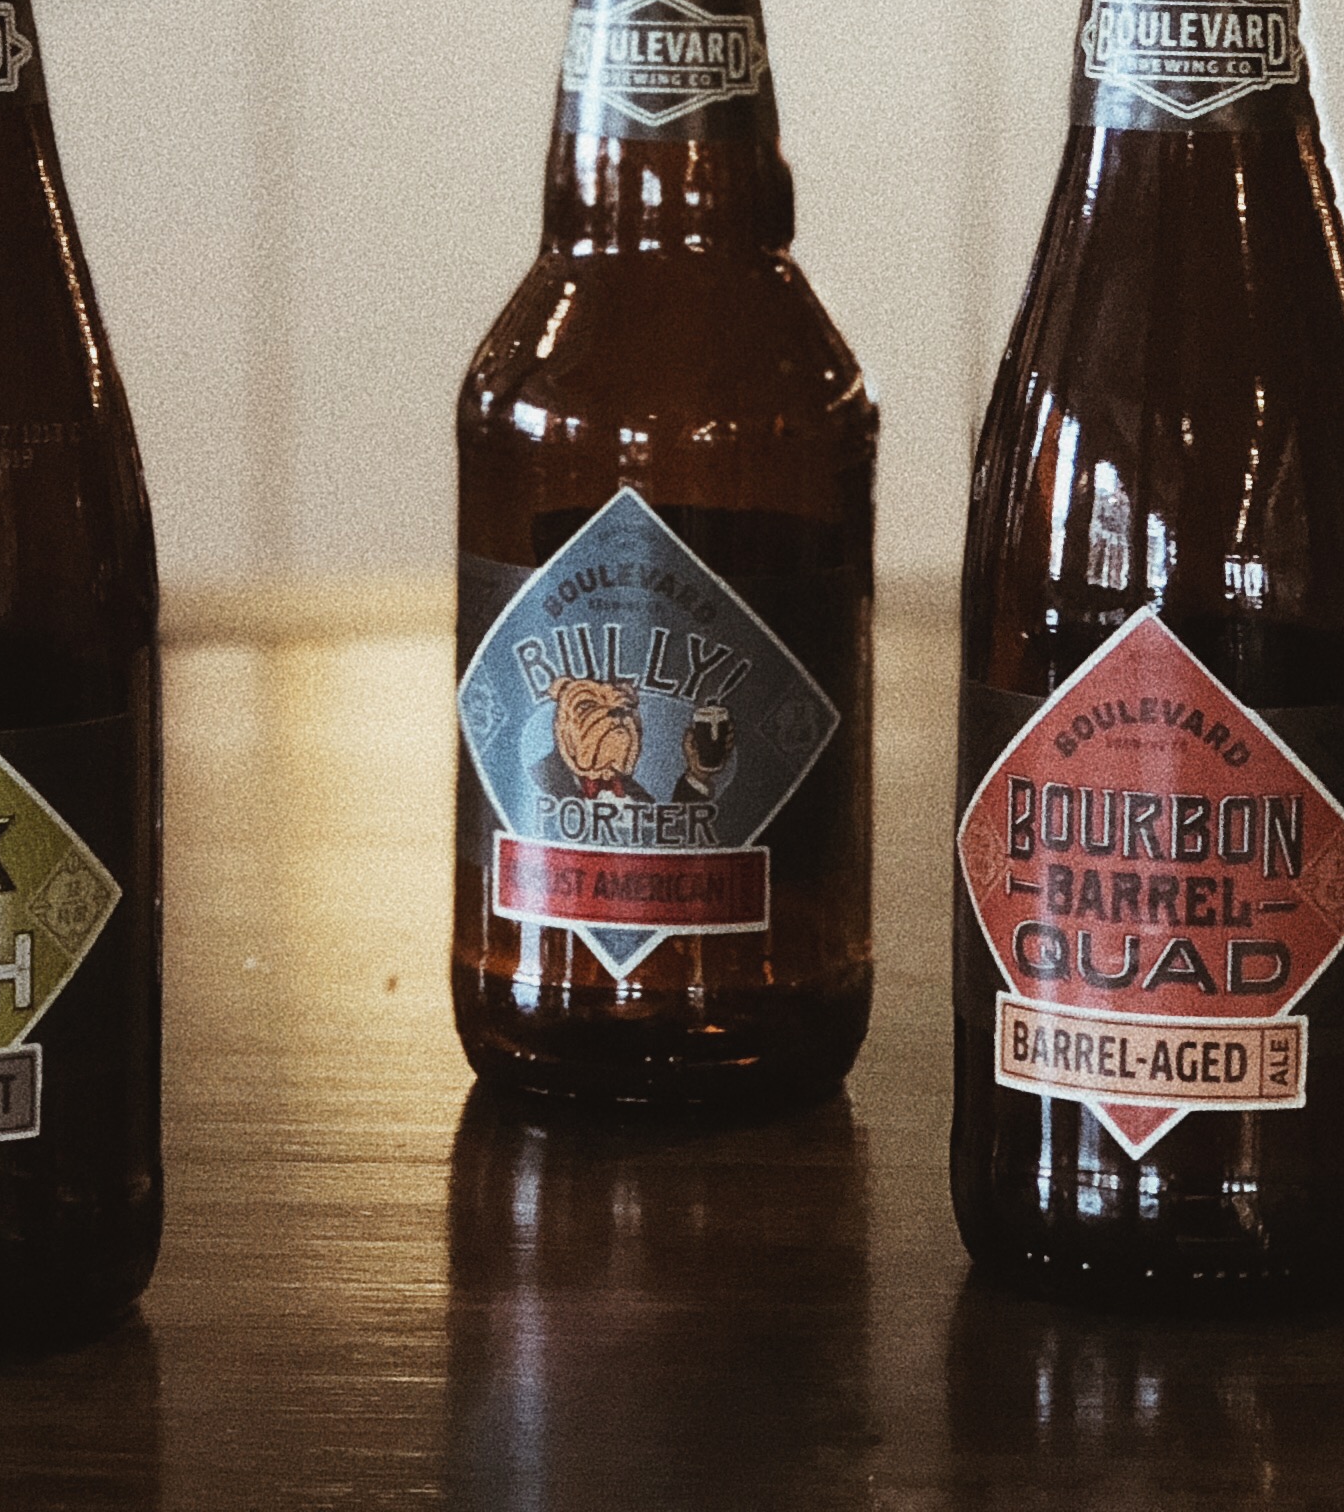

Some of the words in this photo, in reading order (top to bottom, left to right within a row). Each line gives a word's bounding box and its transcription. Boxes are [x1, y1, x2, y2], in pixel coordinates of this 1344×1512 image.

[577, 28, 746, 79] BULEVARD
[1096, 7, 1286, 66] BOULEVARD
[543, 562, 717, 624] BOULEVARD
[512, 623, 752, 705] BULLY!
[1054, 697, 1252, 768] BOULEVARD
[536, 794, 721, 846] PORTER
[1007, 774, 1303, 878] BOURBON
[1046, 863, 1252, 928] BARREL
[1011, 918, 1293, 995] QUAD
[1012, 1020, 1248, 1083] BARREL-AGED
[1268, 1037, 1290, 1086] ALE
